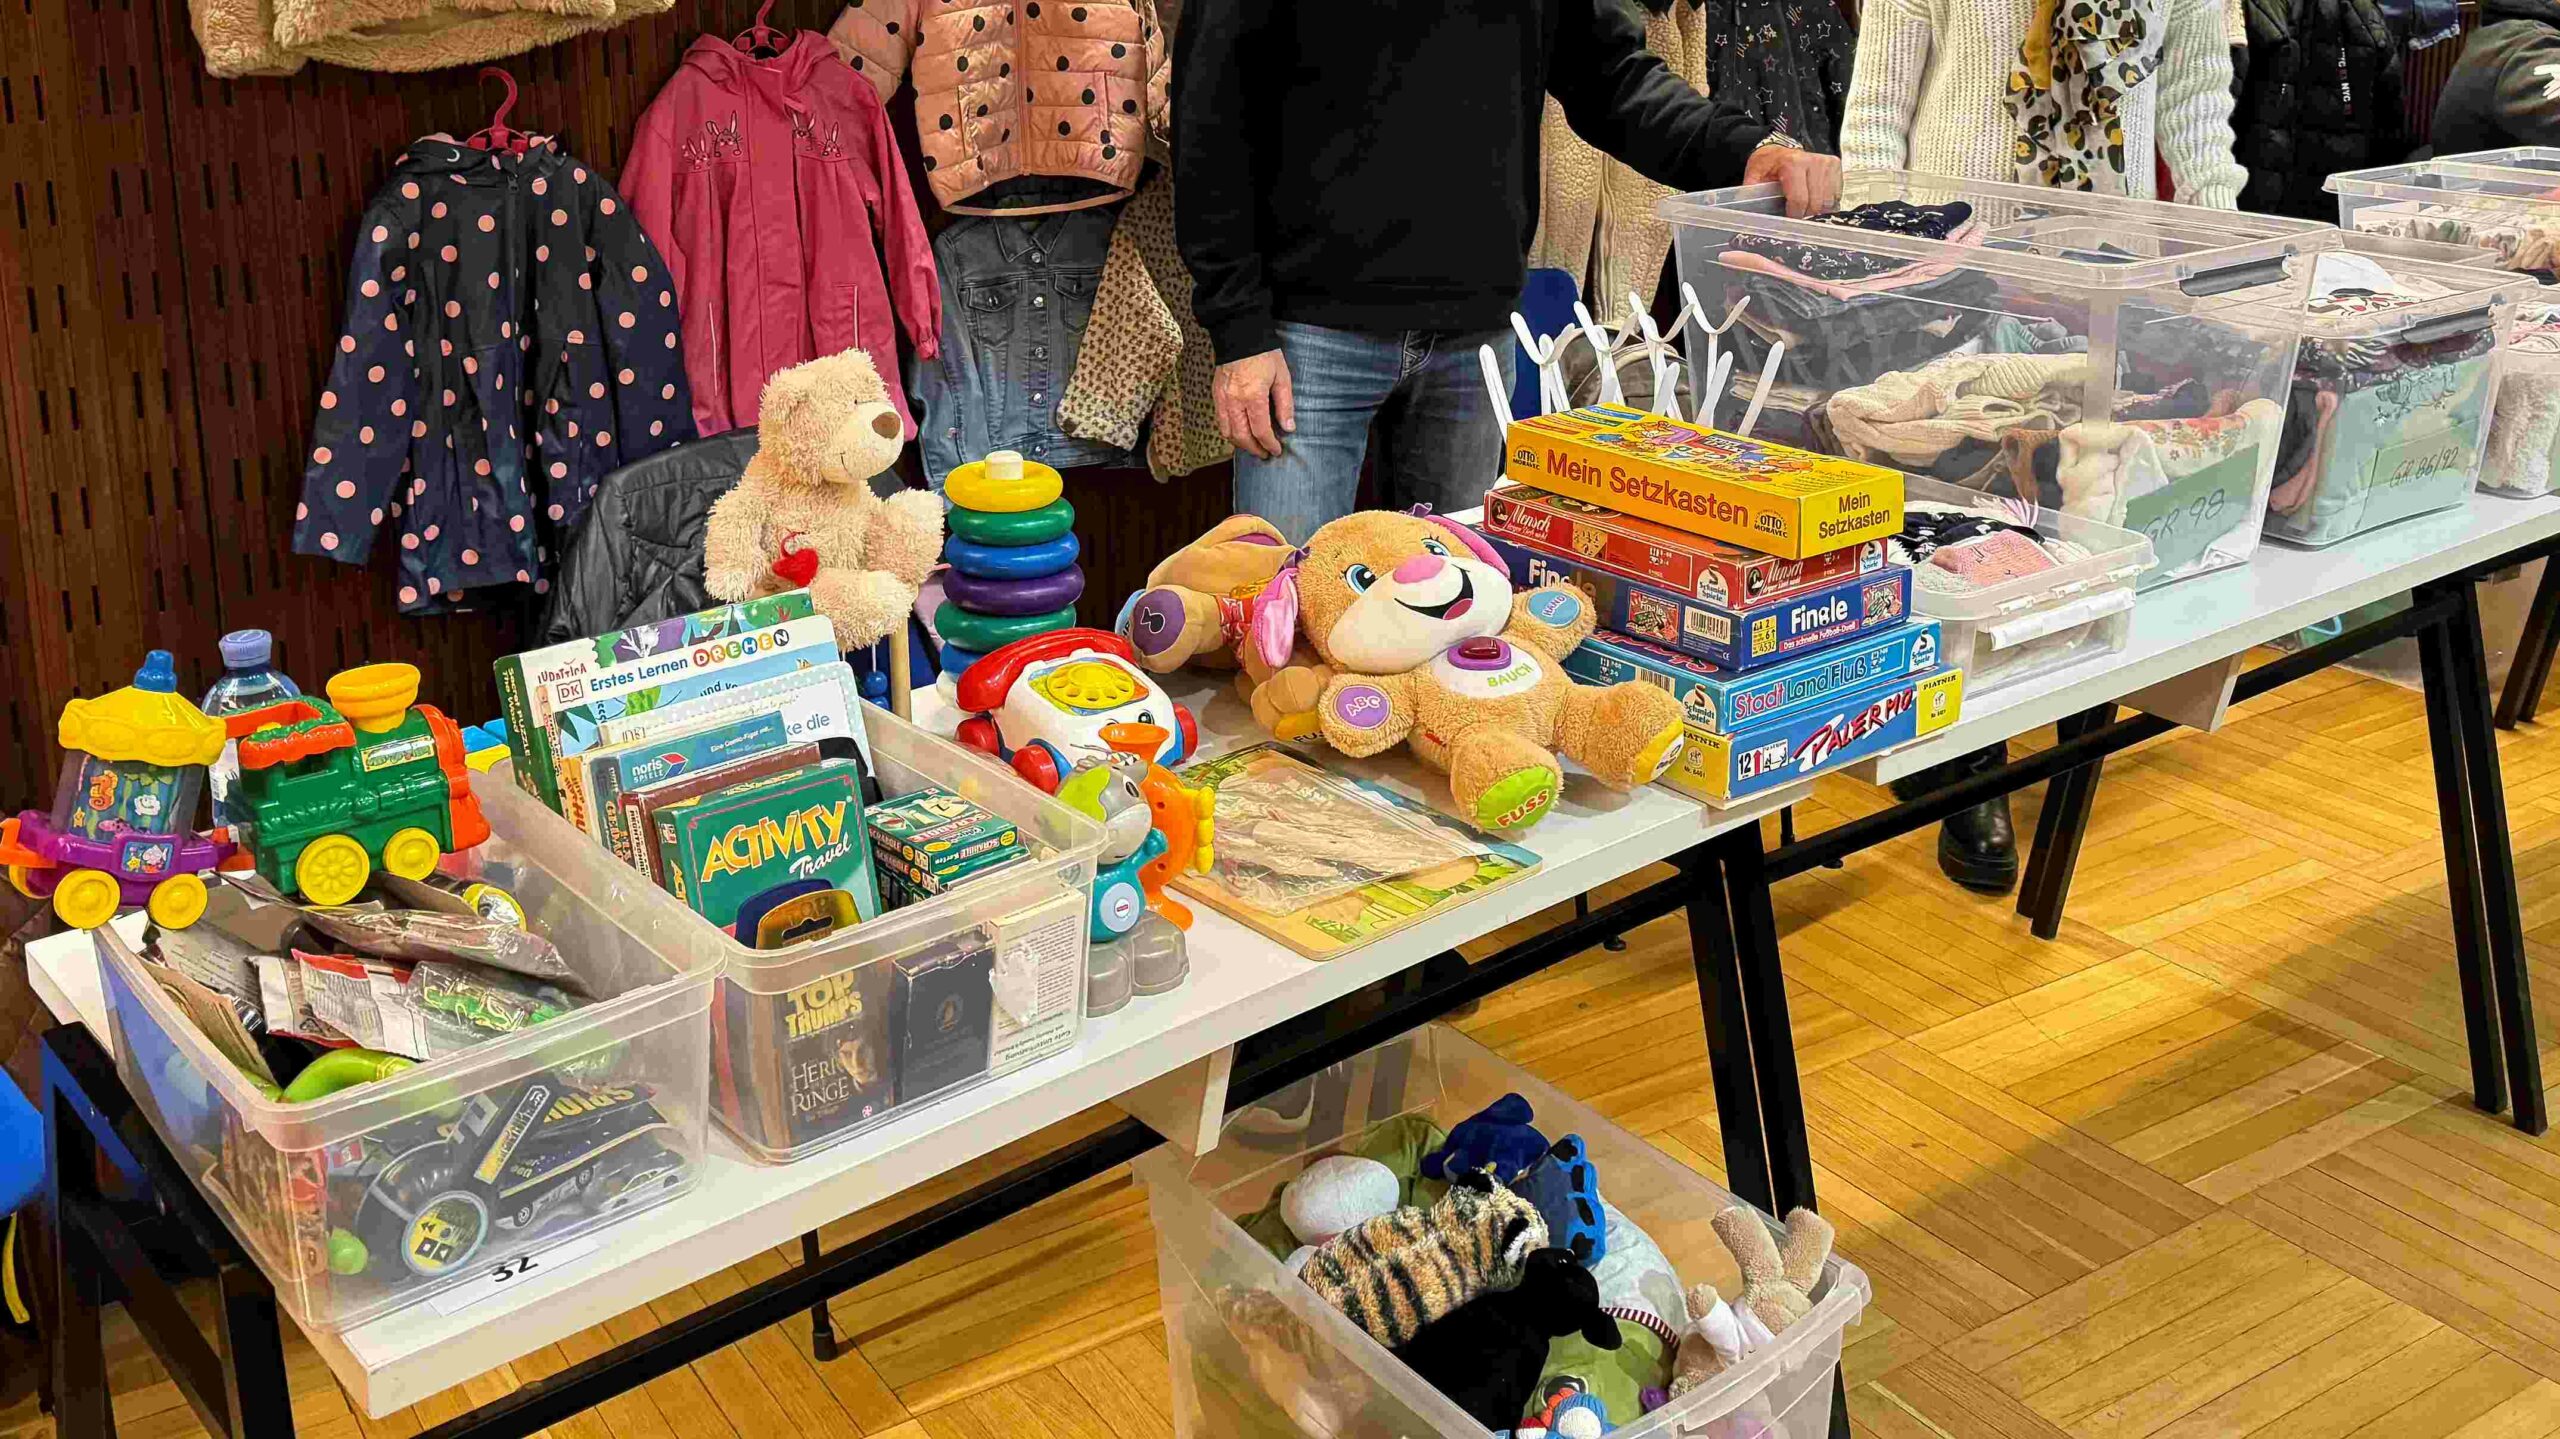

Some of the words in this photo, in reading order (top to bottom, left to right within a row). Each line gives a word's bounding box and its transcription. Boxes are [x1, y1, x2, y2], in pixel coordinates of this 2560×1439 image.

[2341, 82, 2351, 102] NYC
[1517, 451, 1535, 463] OTTO
[1547, 449, 1602, 488] Mein
[1609, 466, 1749, 527] Setzkasten
[1838, 492, 1871, 514] Mein
[2189, 488, 2225, 528] 98
[1760, 514, 1782, 529] OTTO
[1818, 508, 1890, 540] Setzkasten
[1698, 580, 1727, 596] Schmidt
[1702, 589, 1723, 602] Spiele
[590, 671, 634, 692] Erstes
[638, 658, 689, 680] Lernen
[693, 628, 790, 667] DREHEN
[1486, 662, 1535, 688] BAUCH
[1922, 675, 1957, 691] PIATNIK
[560, 684, 580, 700] DK
[1734, 682, 1785, 720] Stadt
[1786, 668, 1829, 702] Land
[1829, 656, 1867, 688] Fluß
[1345, 695, 1381, 717] ABC
[1684, 700, 1715, 720] Schmidt
[806, 713, 830, 730] die
[1687, 710, 1711, 725] Spiele
[1792, 689, 1914, 765] PALERMO
[1684, 729, 1721, 749] IATNIK
[632, 758, 663, 776] noris
[1739, 752, 1751, 775] 12
[633, 770, 664, 784] SPIELE
[1496, 788, 1550, 828] FUSS
[701, 801, 847, 883] ACTIVITY
[789, 831, 853, 880] Travel
[787, 971, 855, 1015] TOP
[785, 991, 863, 1038] TRUMPS
[790, 1075, 851, 1117] RINGE
